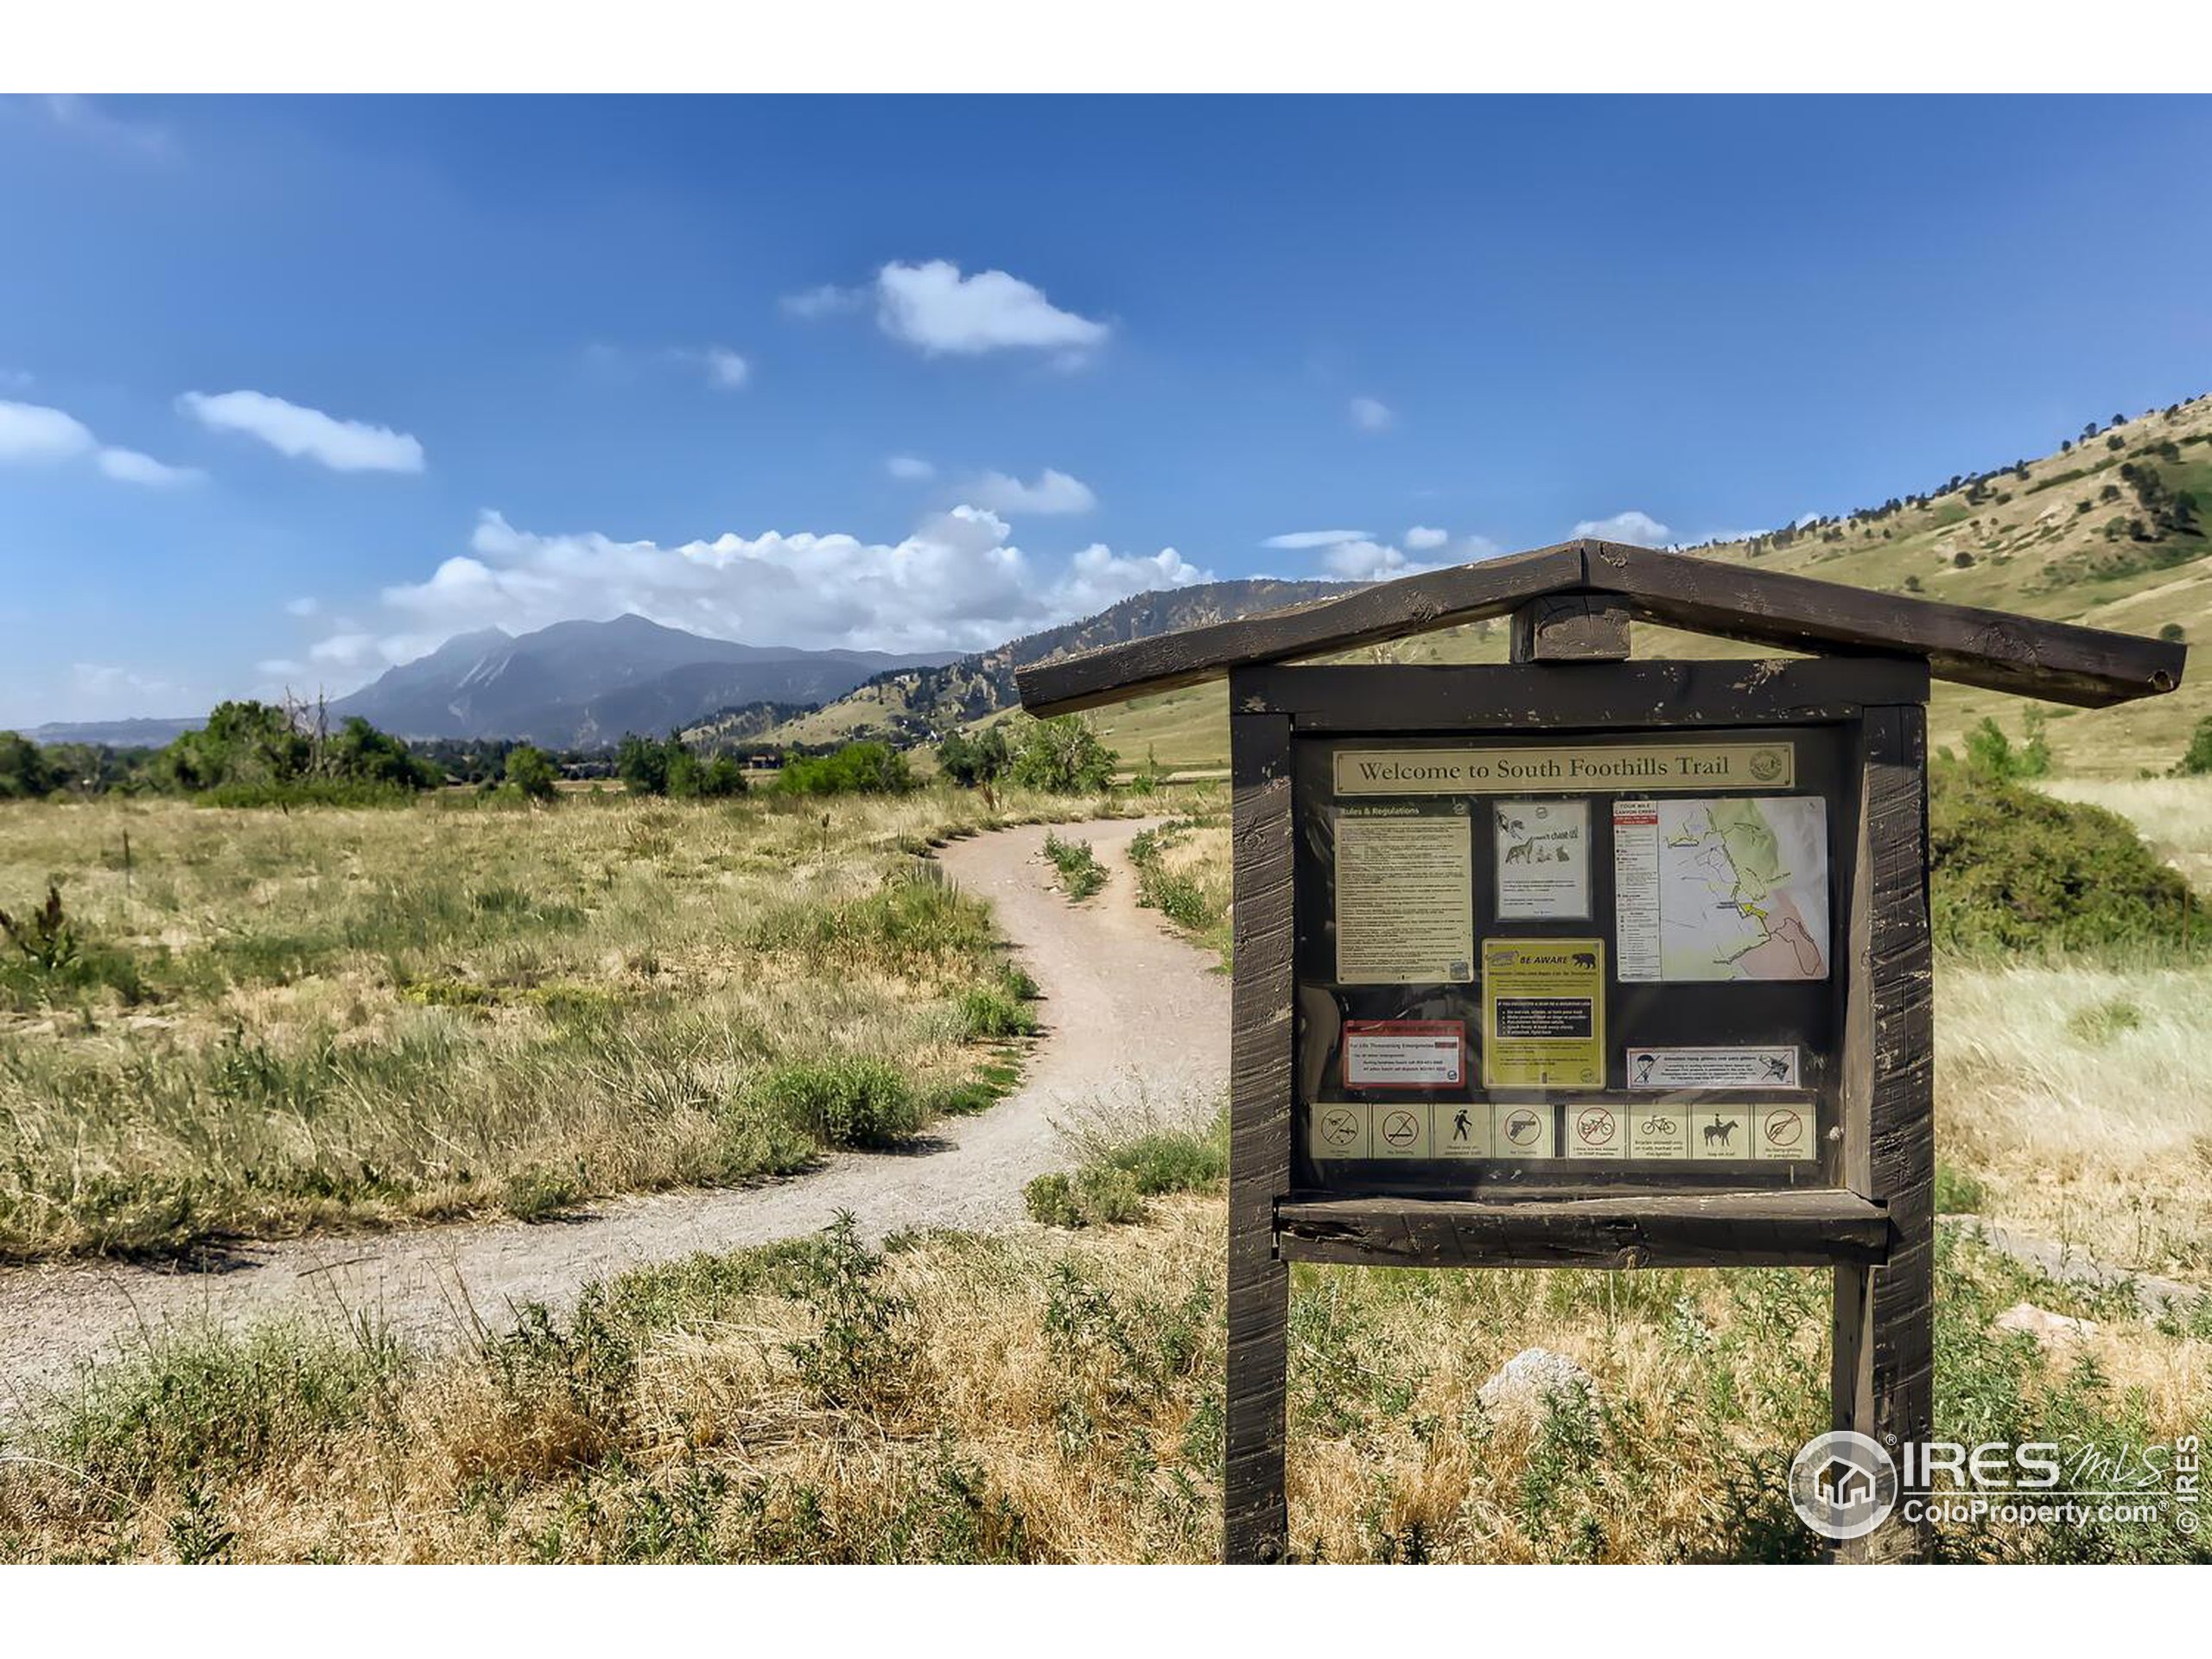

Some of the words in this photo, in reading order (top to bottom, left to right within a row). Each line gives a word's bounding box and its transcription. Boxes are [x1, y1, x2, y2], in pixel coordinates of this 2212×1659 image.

[1359, 762, 1462, 780] Welcome
[1469, 764, 1490, 778] to
[1497, 759, 1561, 779] South
[1569, 758, 1669, 777] Foothills
[1675, 756, 1730, 775] Trail
[1363, 806, 1370, 815] &
[1372, 806, 1420, 817] Regulations
[1520, 956, 1533, 964] BE
[1534, 955, 1568, 964] AWARE
